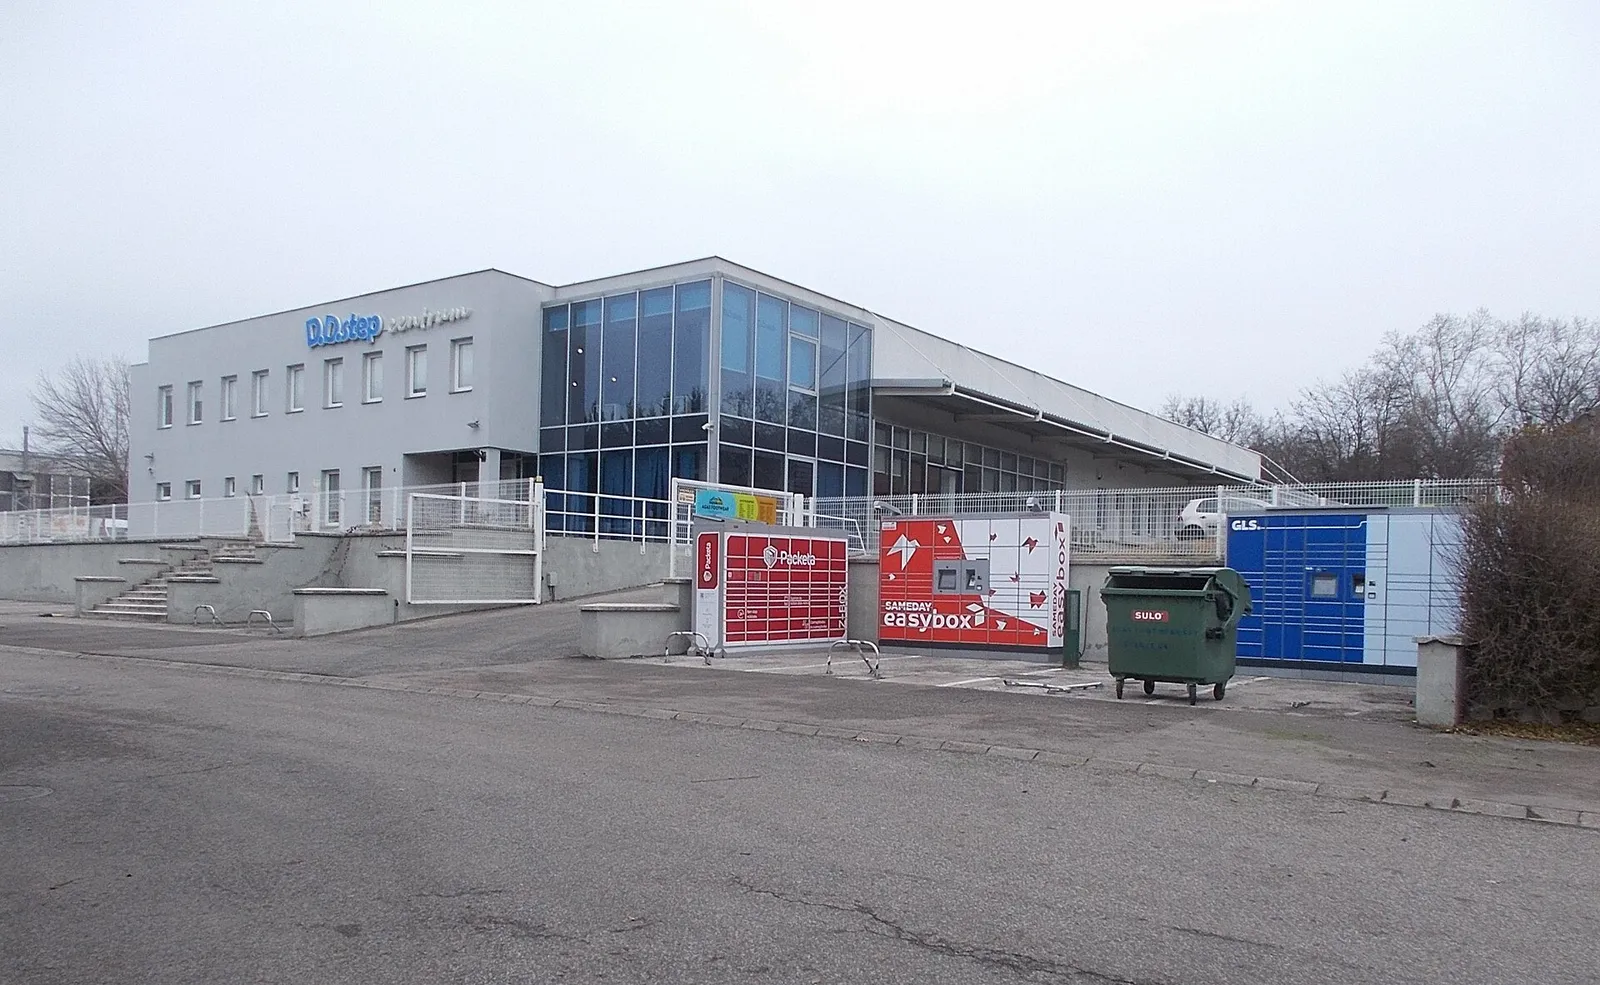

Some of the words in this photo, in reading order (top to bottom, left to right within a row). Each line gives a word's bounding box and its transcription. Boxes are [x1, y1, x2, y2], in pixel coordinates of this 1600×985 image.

[780, 550, 816, 567] Packeta
[1056, 538, 1066, 638] easybox
[885, 601, 932, 611] SAMEDAY
[883, 608, 972, 632] easybox
[1134, 611, 1162, 621] SULO
